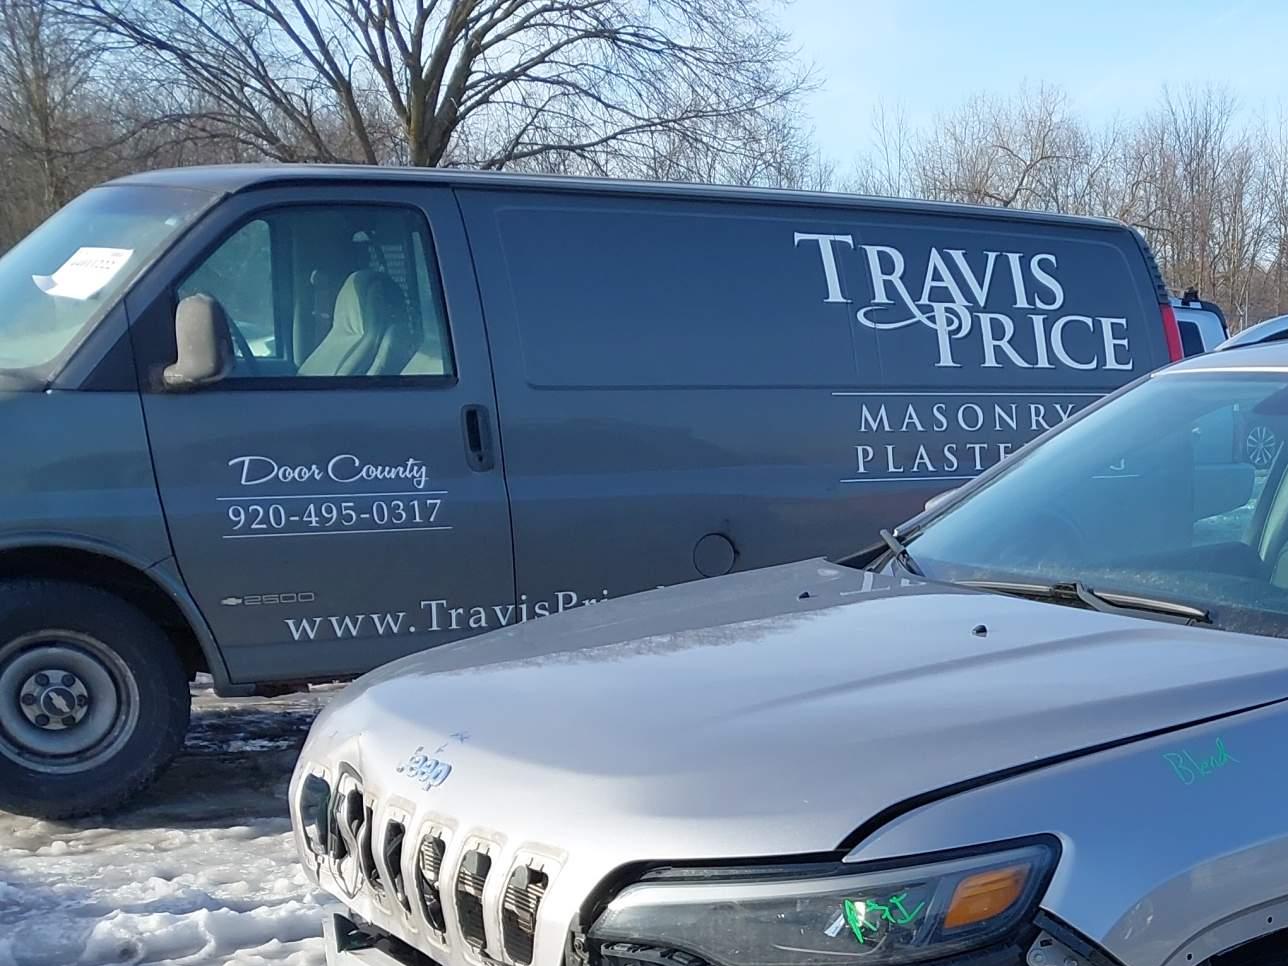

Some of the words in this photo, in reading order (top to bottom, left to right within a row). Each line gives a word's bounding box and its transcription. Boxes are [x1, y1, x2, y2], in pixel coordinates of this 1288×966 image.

[794, 231, 1065, 329] TRAVIS
[930, 303, 1134, 370] PRICE
[859, 402, 1075, 431] MASONRY
[228, 456, 323, 486] Door
[328, 454, 429, 488] County
[856, 442, 1028, 473] PLASTE
[228, 499, 442, 530] 920-495-0317
[243, 592, 315, 606] 2500
[284, 589, 608, 642] www.TravisP
